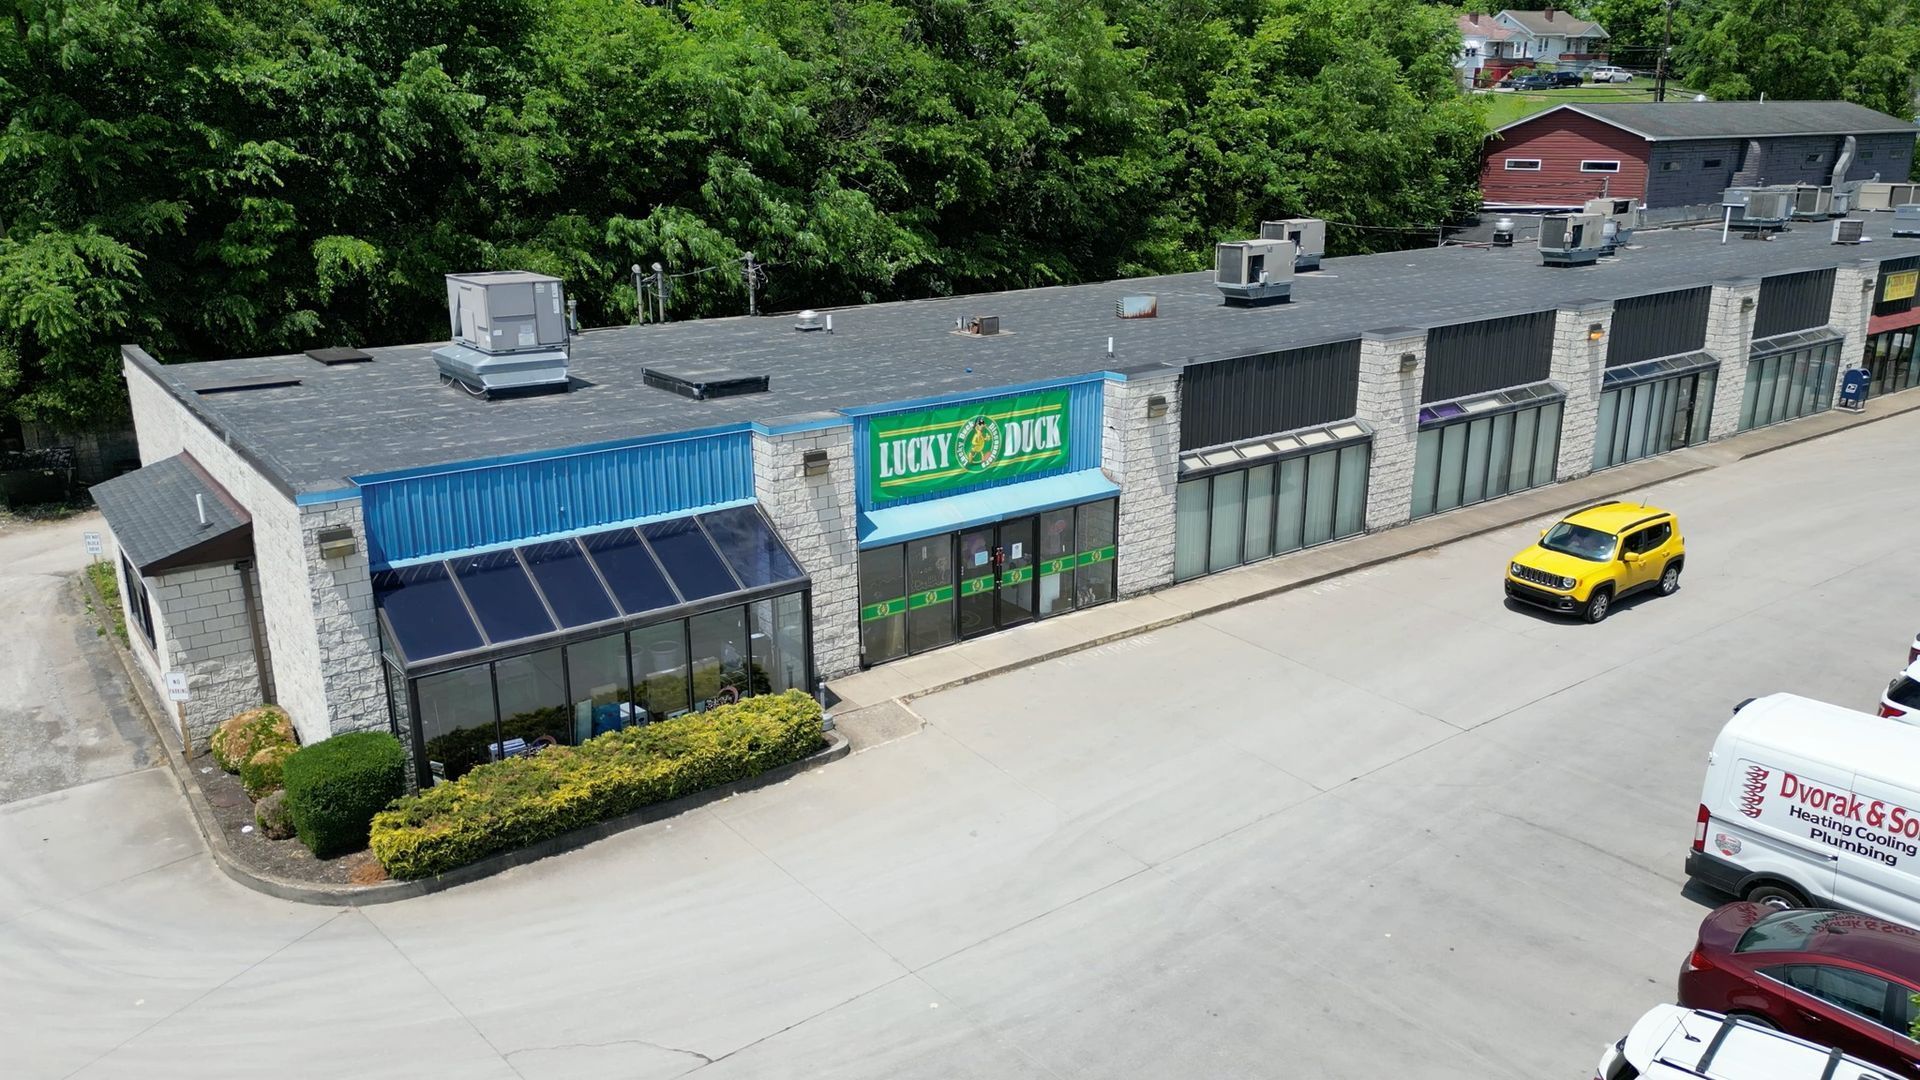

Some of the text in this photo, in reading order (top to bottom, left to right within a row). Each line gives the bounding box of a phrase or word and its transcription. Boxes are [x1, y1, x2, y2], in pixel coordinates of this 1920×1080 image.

[879, 414, 1061, 478] LUCKY DUCK
[957, 421, 999, 468] Lucky Duck Discounters
[1779, 772, 1920, 841] Dvorak & So
[1789, 805, 1918, 857] Heating Cooling
[1810, 828, 1898, 867] Plumbing
